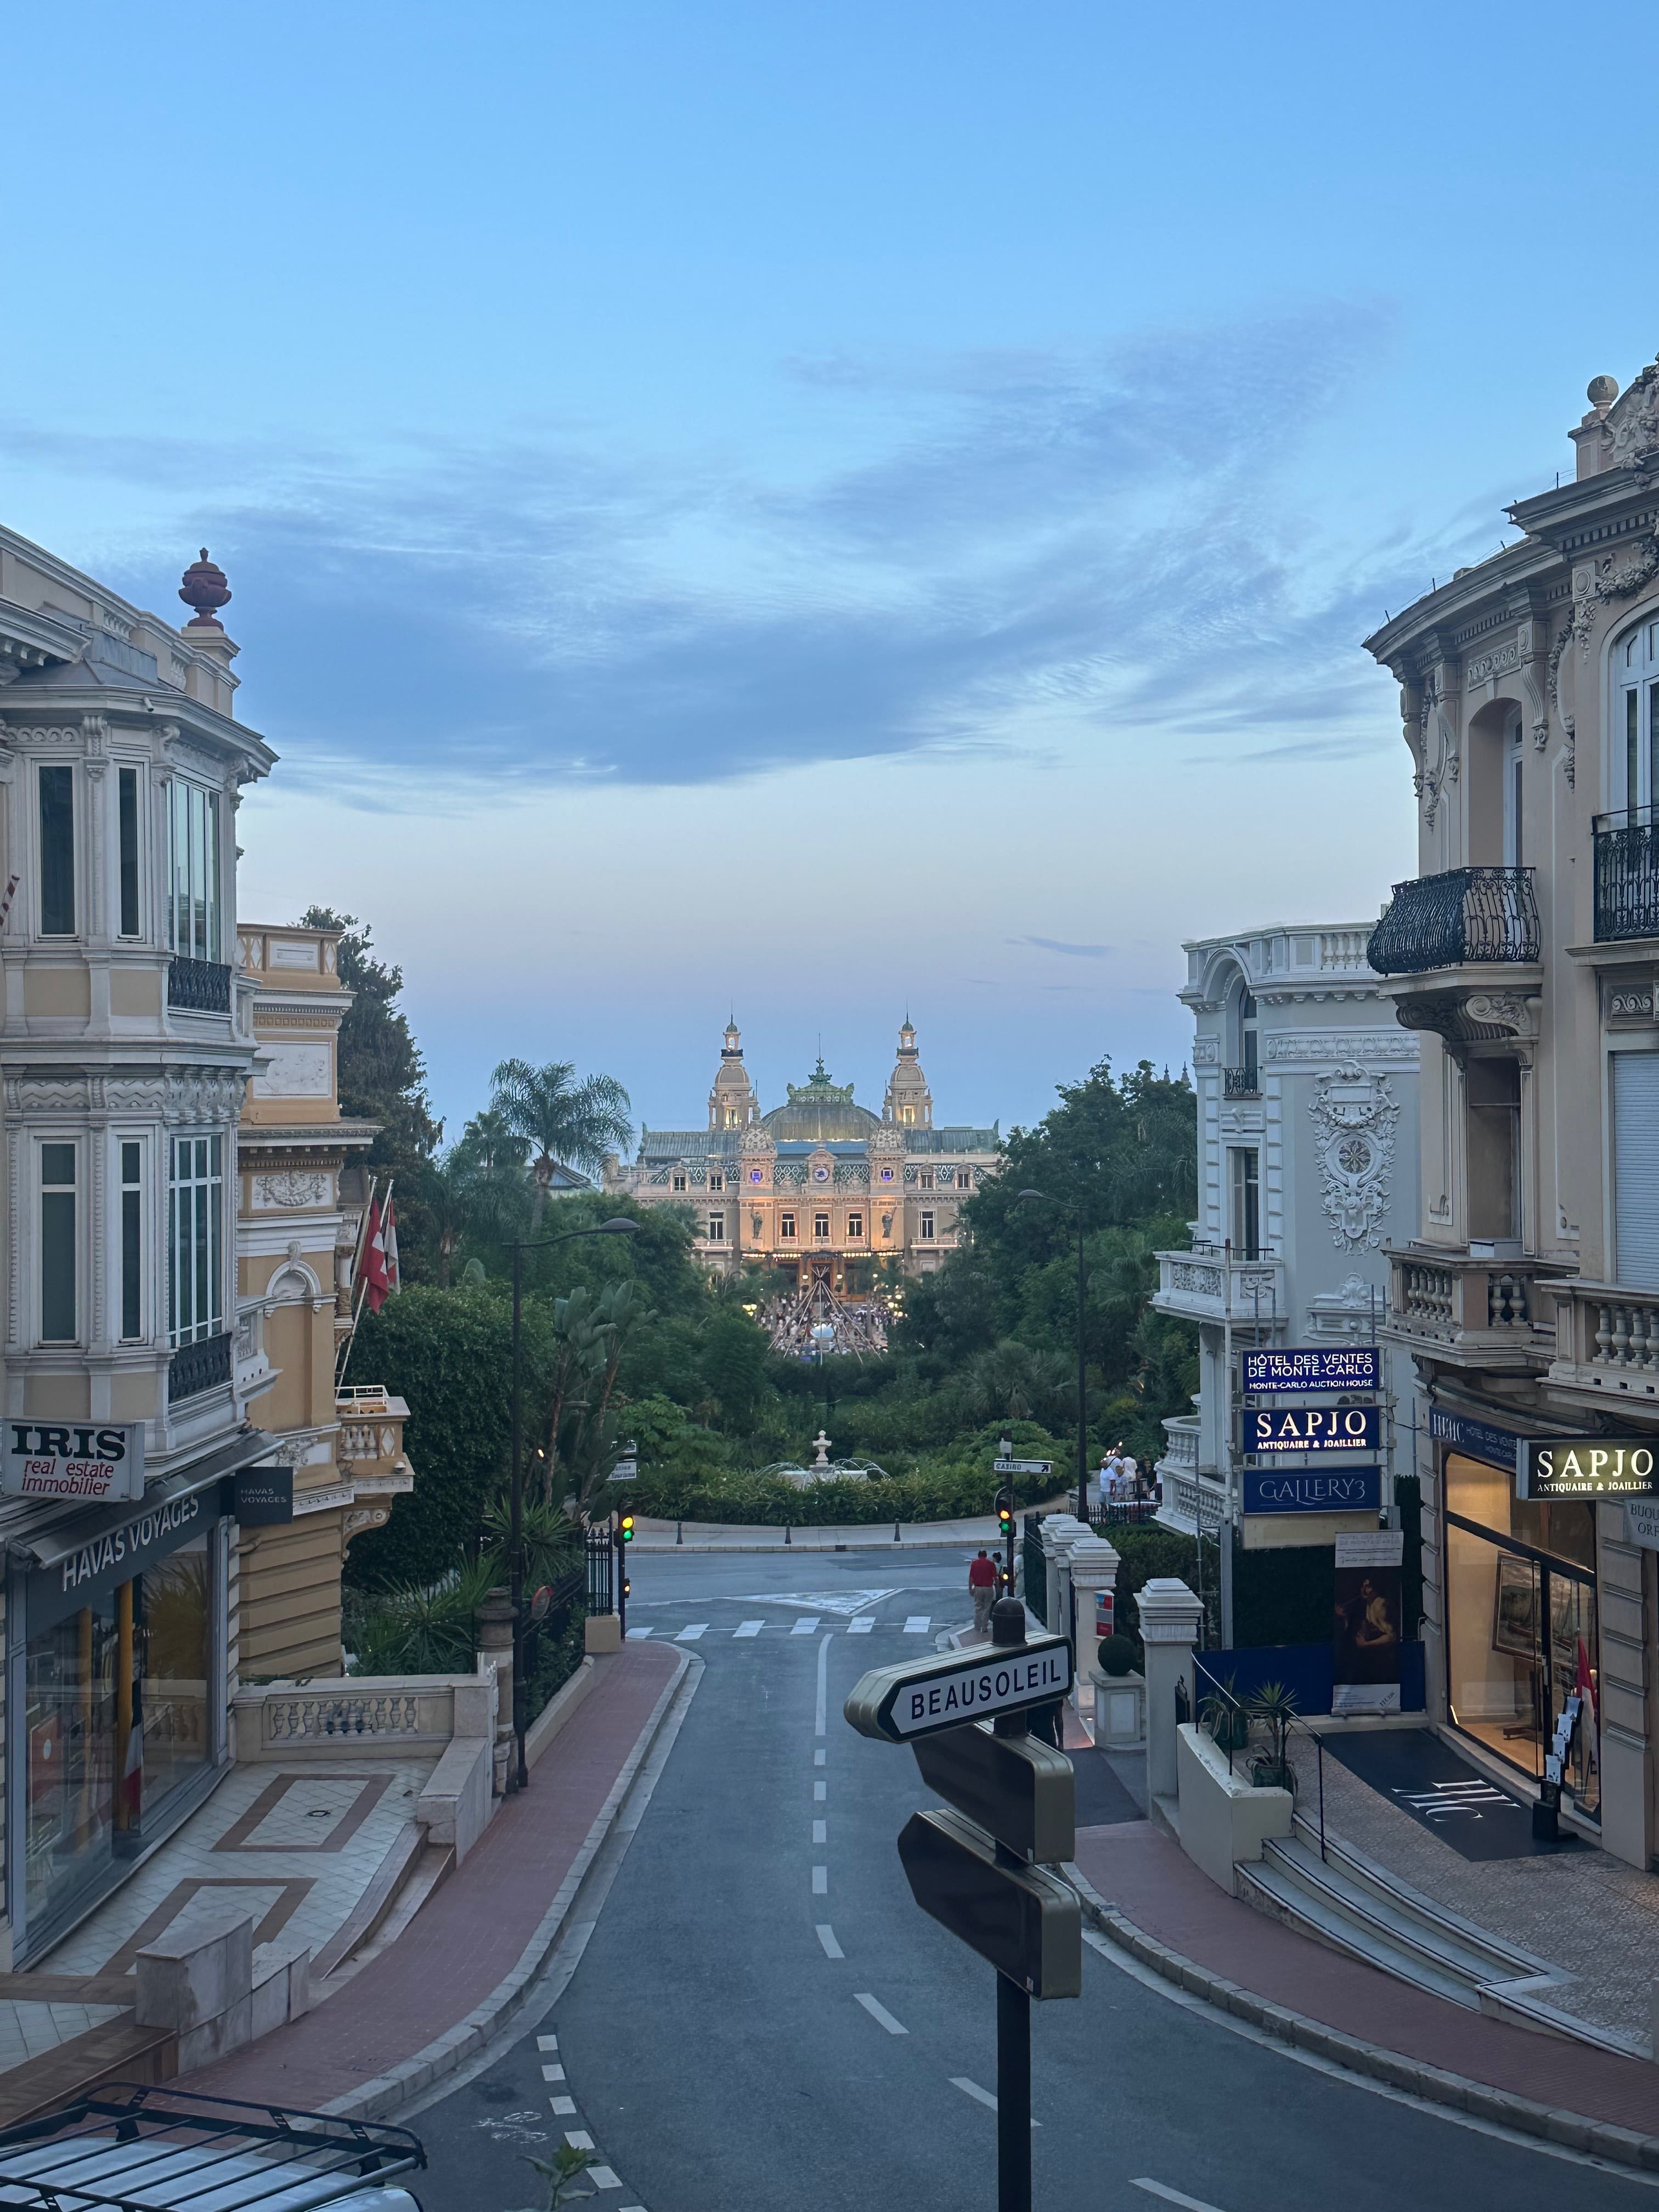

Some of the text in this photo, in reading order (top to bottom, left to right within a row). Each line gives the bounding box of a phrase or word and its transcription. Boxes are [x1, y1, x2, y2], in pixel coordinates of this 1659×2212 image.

[1248, 1353, 1372, 1366] HÔTEL DES VENTES
[1248, 1364, 1373, 1377] DE MONTE-CARLO
[1257, 1411, 1367, 1437] SAPJO
[11, 1425, 126, 1462] IRIS
[1257, 1440, 1309, 1450] ANTIQUAIRE
[1324, 1438, 1367, 1448] JOAILLIER
[24, 1458, 114, 1479] real estate
[1537, 1449, 1654, 1478] SAPJO
[21, 1471, 110, 1496] immobilier
[1538, 1481, 1653, 1493] ANTIQUAIRE & JOAILLIER
[63, 1494, 199, 1591] HAVAS VOYAGES
[911, 1660, 1060, 1720] BEAUSOLEIL
